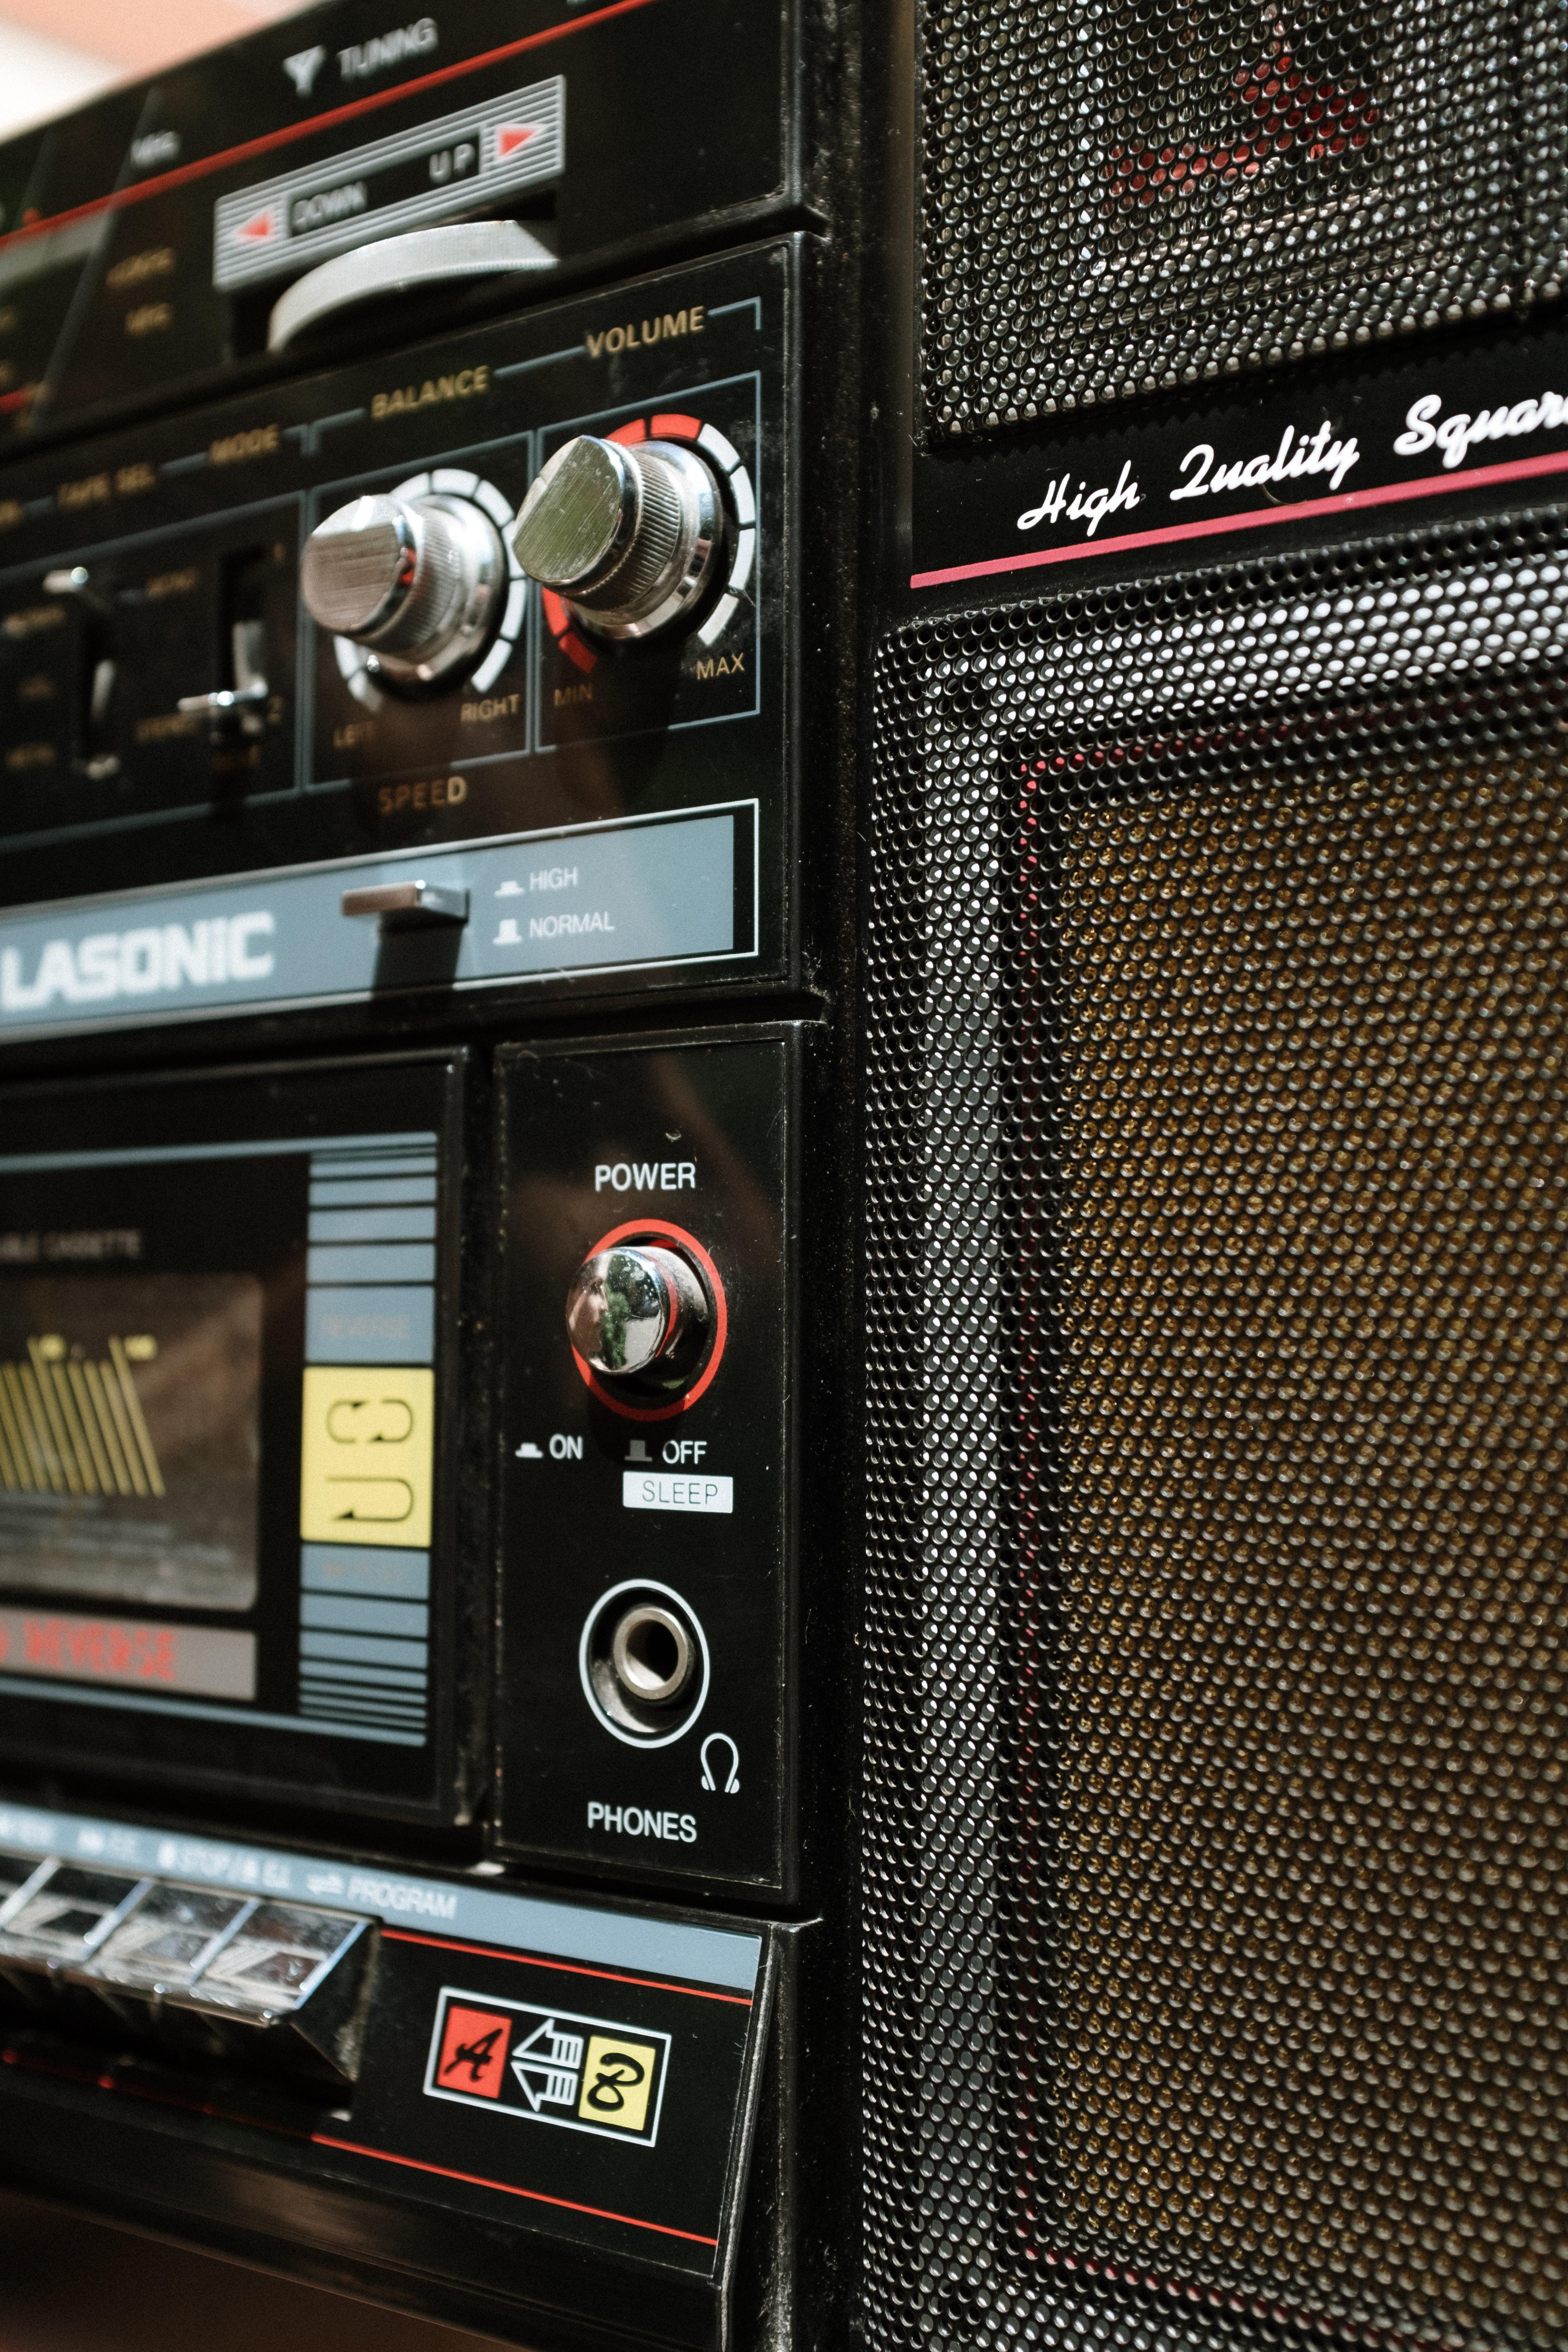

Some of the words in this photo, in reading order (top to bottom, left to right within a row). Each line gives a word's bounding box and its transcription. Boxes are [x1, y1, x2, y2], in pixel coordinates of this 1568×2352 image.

[337, 18, 439, 80] TUNING
[429, 143, 475, 184] UP
[293, 181, 367, 231] DOWN
[587, 306, 706, 359] VOLUME
[371, 365, 490, 419] BALANCE
[1017, 460, 1140, 536] High
[1170, 421, 1360, 501] Quality
[696, 652, 745, 680] MAX
[461, 693, 521, 723] RIGHT
[554, 684, 593, 707] MIN
[335, 720, 376, 747] LEFT
[378, 776, 468, 814] SPEED
[530, 866, 578, 893] HIGH
[529, 911, 615, 939] NORMAL
[1, 909, 276, 1012] LASONIC
[595, 1162, 696, 1192] POWER
[549, 1435, 583, 1460] ON
[662, 1440, 707, 1465] OFF
[642, 1480, 719, 1505] SLEEP
[588, 1801, 698, 1843] PHONES
[347, 1875, 458, 1920] PROGRAM
[443, 2027, 503, 2082] A
